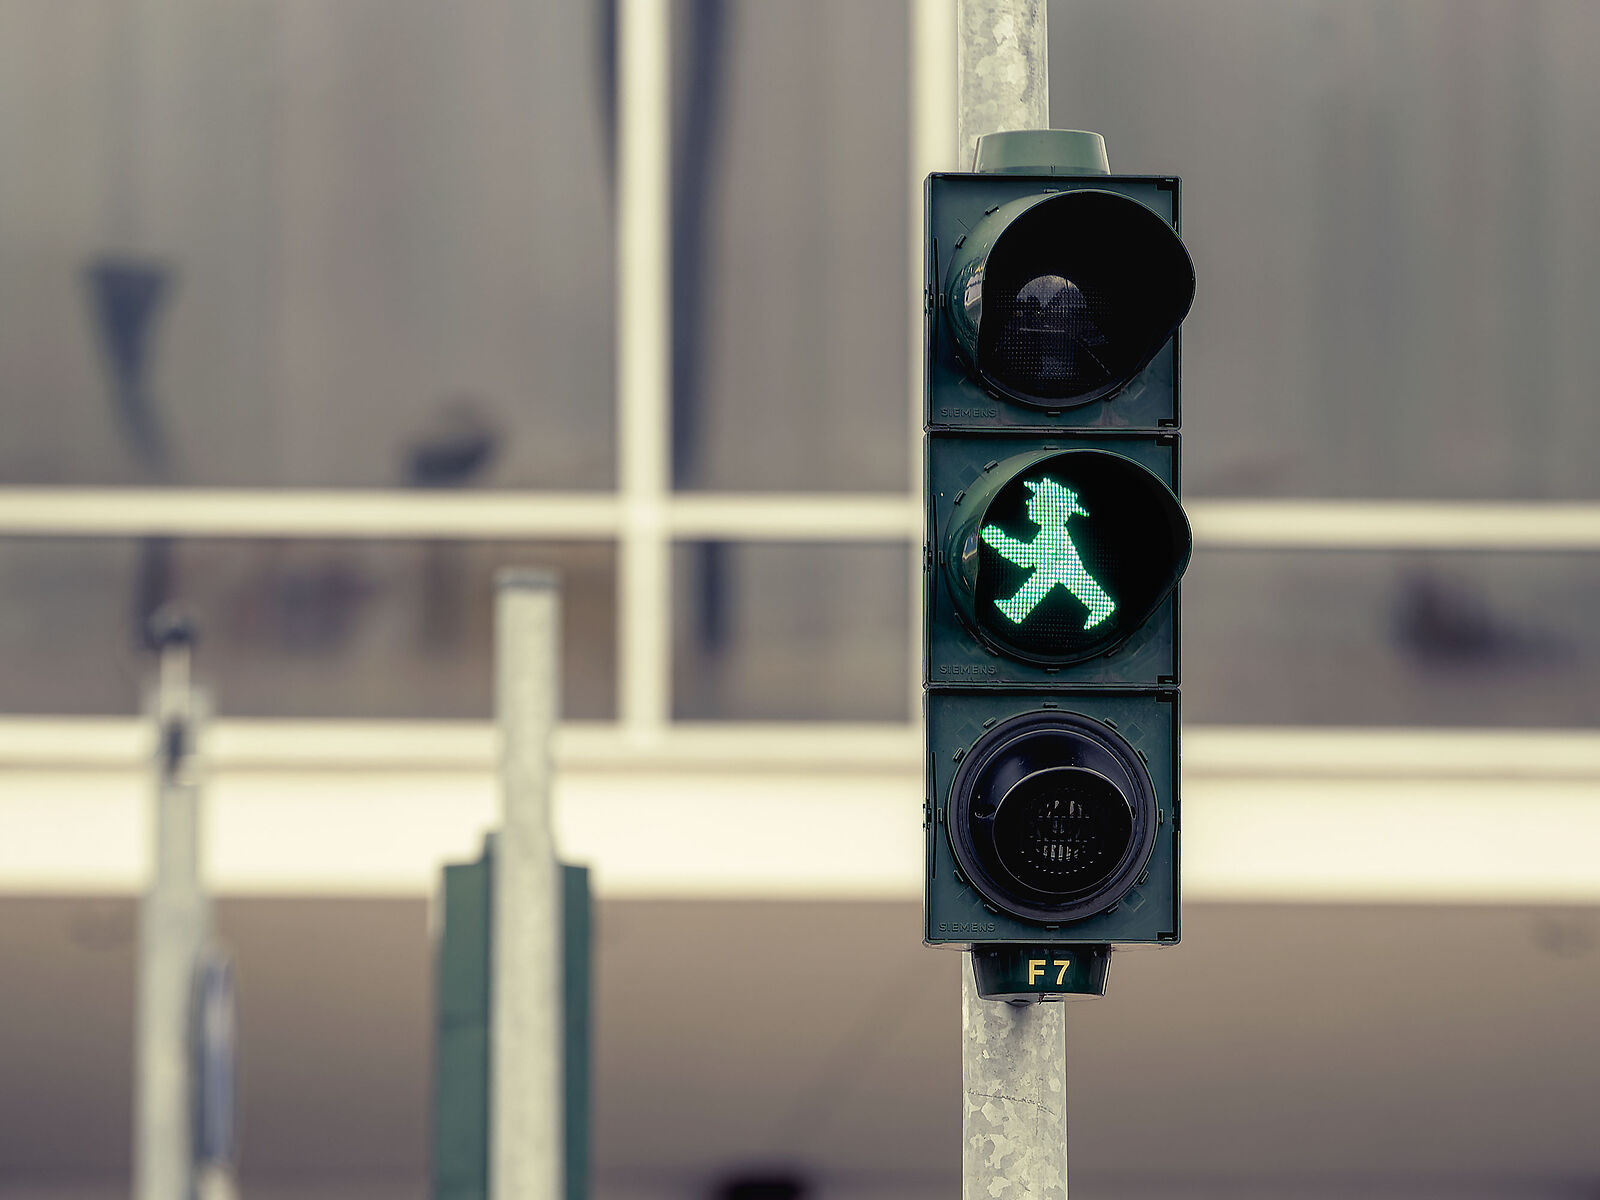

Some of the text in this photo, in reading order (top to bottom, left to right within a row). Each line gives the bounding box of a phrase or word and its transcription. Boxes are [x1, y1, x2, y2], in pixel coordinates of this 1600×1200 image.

[940, 408, 997, 418] SIEMENS
[940, 664, 997, 675] SIEMENS
[939, 922, 996, 933] SIEMENS
